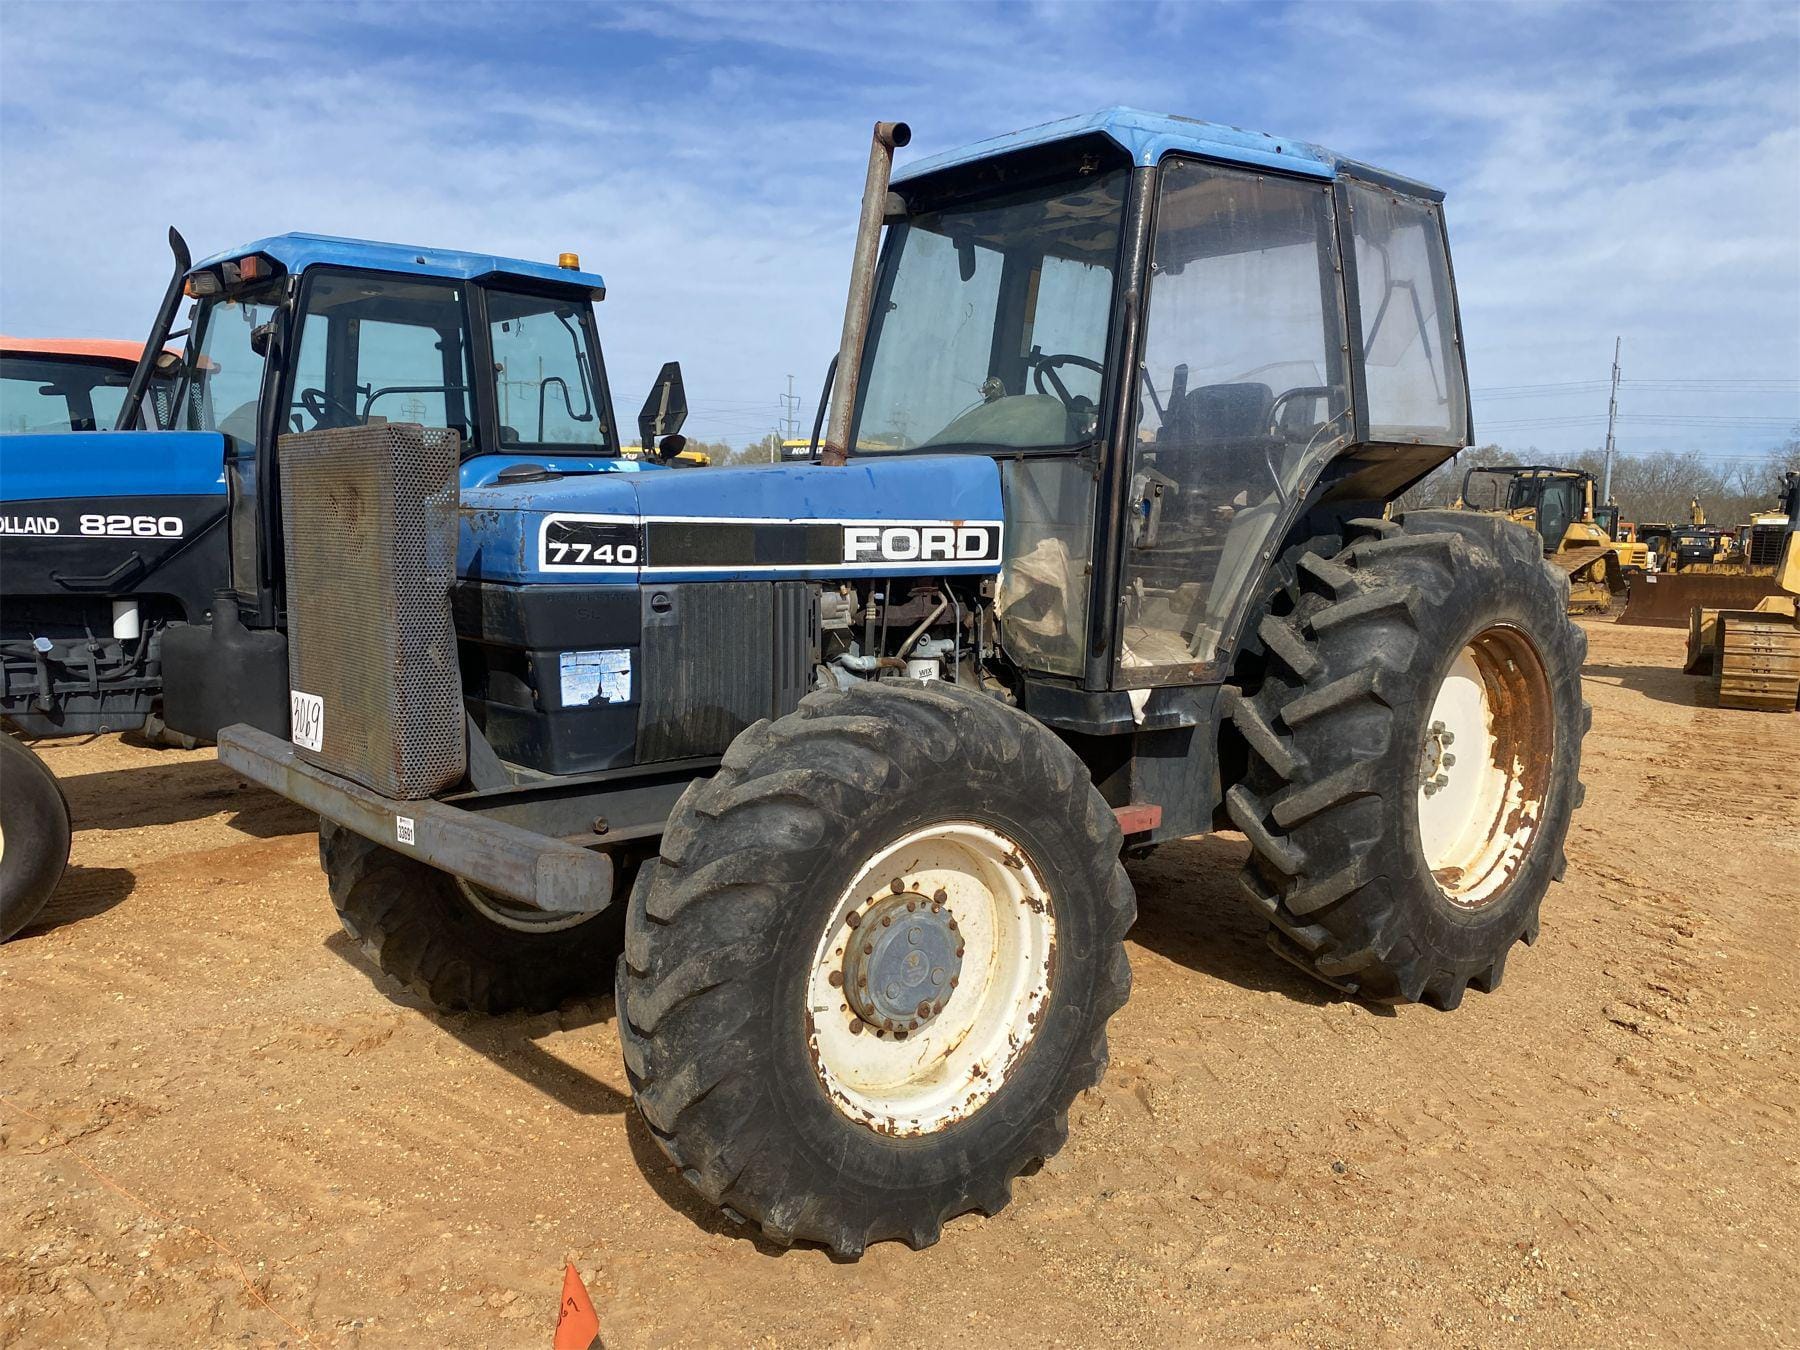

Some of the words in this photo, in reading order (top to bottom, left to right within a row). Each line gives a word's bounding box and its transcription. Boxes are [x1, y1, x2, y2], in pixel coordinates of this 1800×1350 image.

[79, 514, 184, 537] 8260
[548, 542, 638, 564] 7740
[843, 527, 989, 561] FORD
[918, 667, 932, 679] WIX
[294, 696, 321, 741] 3069
